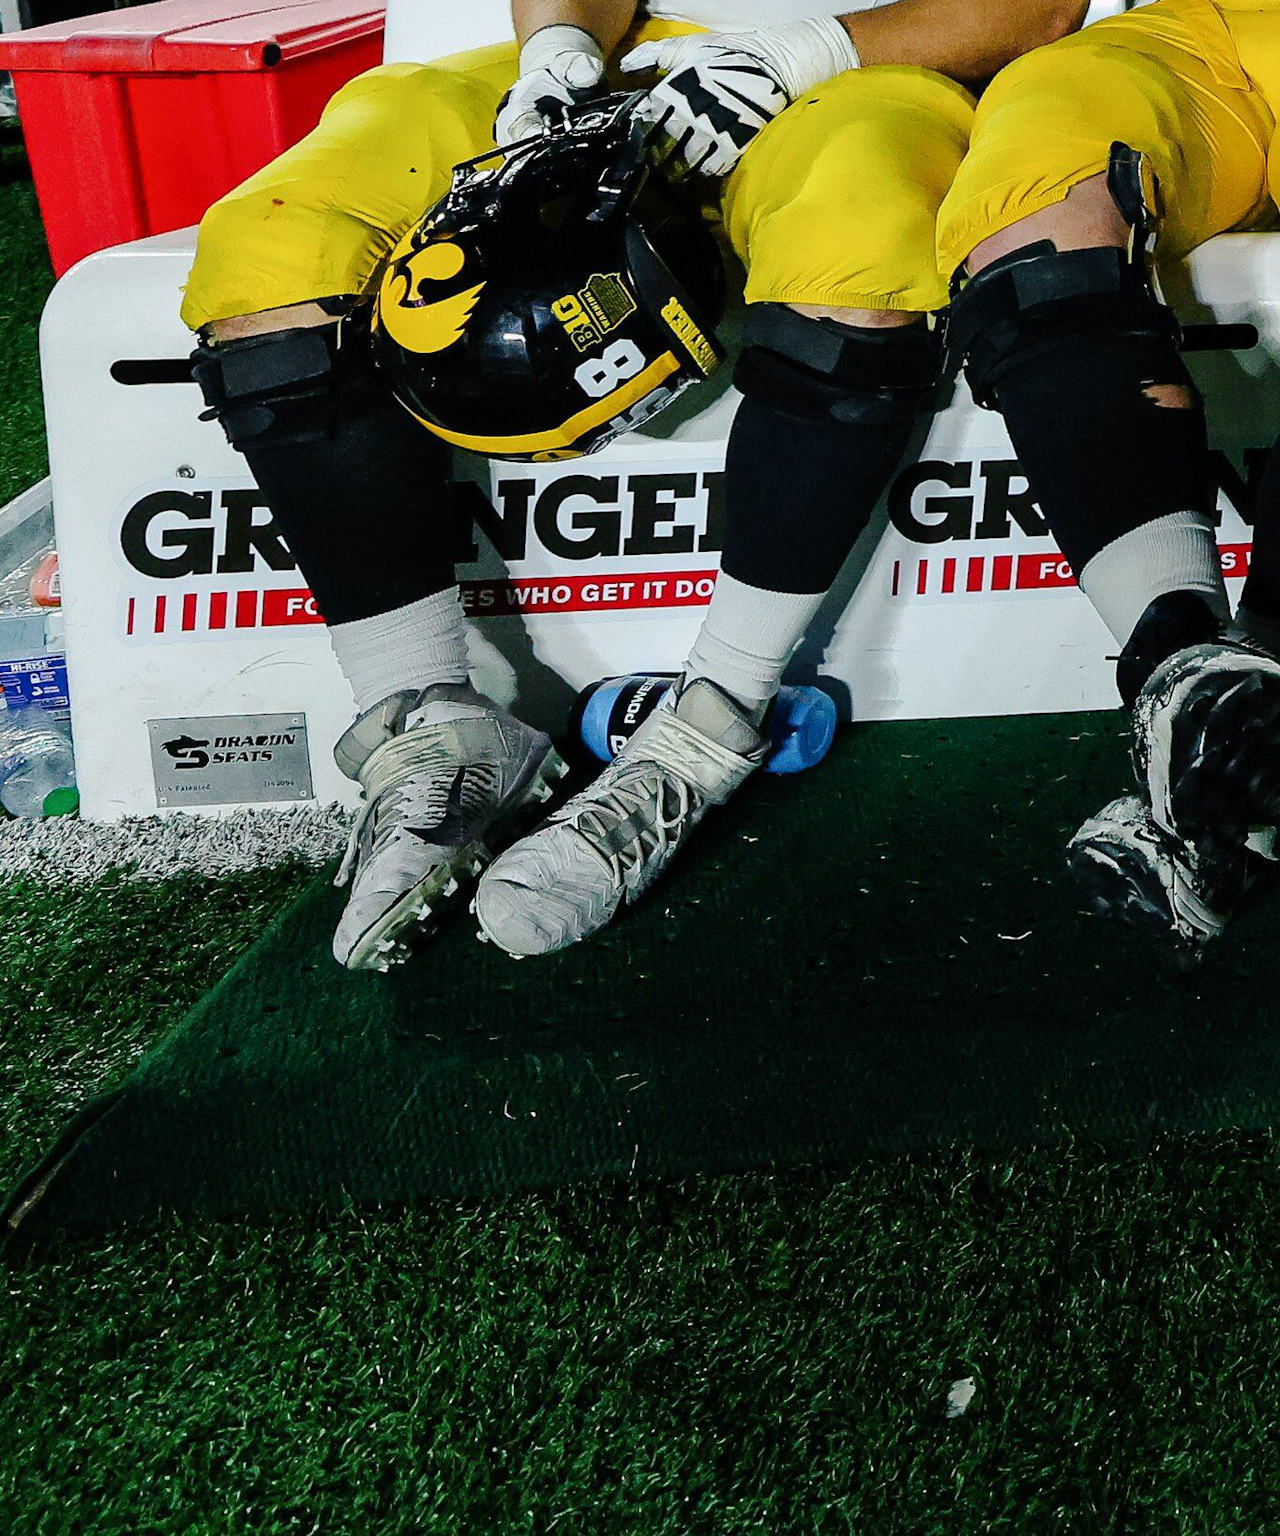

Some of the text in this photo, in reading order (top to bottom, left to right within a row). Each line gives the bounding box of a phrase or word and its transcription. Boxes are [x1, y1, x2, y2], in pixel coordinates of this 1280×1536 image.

[583, 291, 612, 335] WARNING
[507, 582, 572, 606] WHO
[580, 580, 635, 602] GET
[641, 578, 666, 599] IT
[212, 750, 273, 764] SEATS
